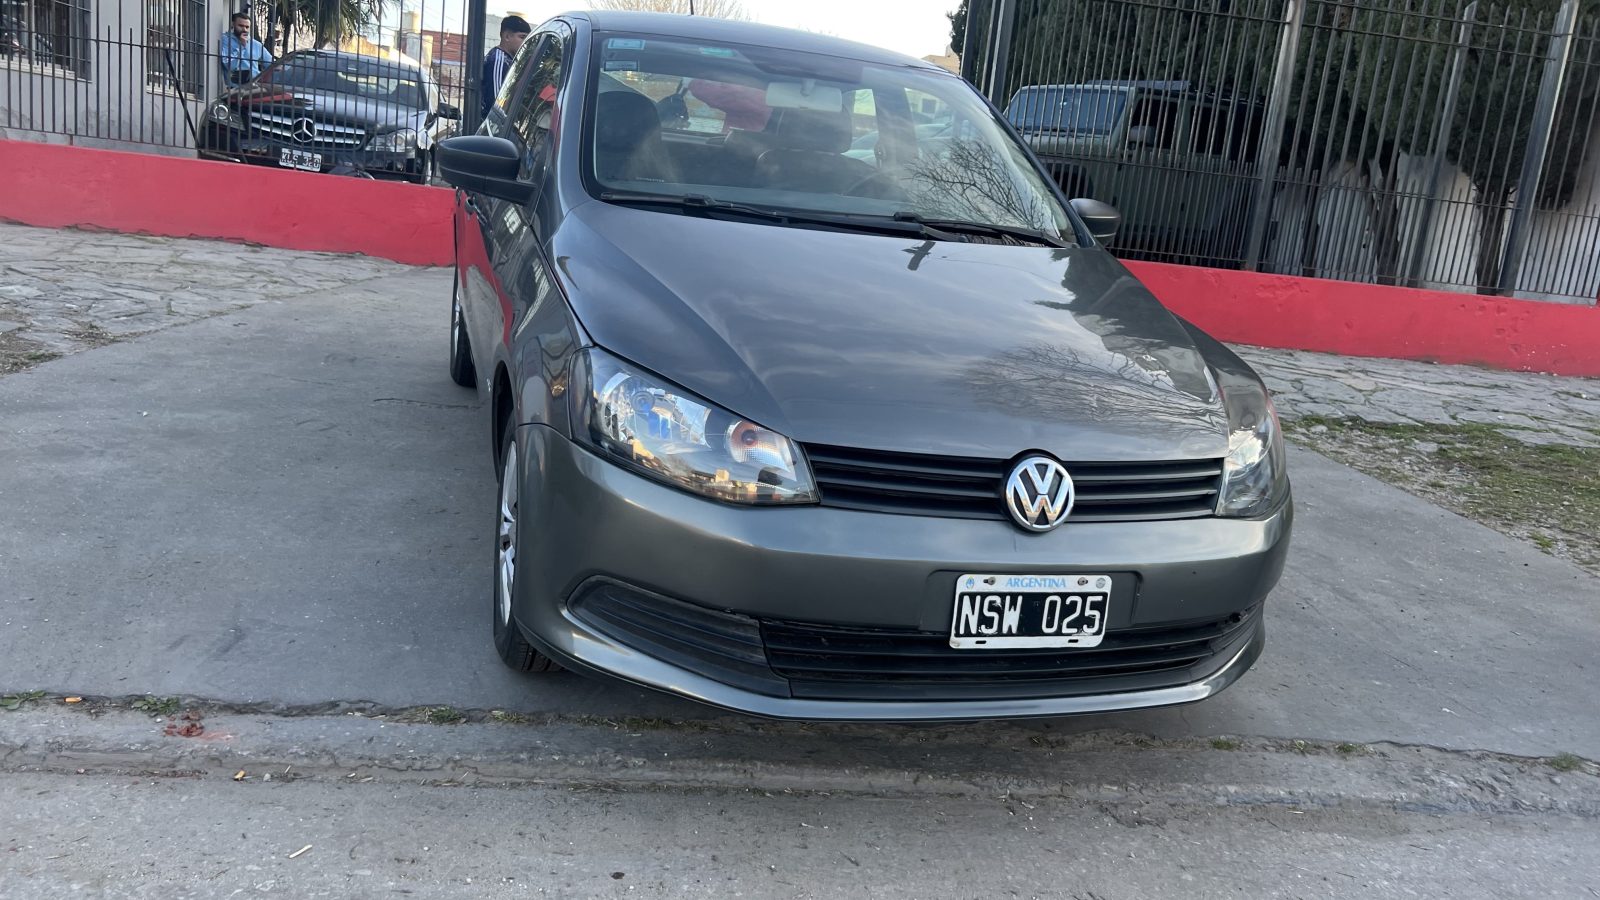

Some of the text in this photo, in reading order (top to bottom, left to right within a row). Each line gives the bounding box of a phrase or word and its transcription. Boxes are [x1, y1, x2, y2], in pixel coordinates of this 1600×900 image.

[1008, 458, 1073, 530] VW
[1005, 577, 1067, 588] ARGENTINA
[959, 595, 1103, 634] NSW 025
